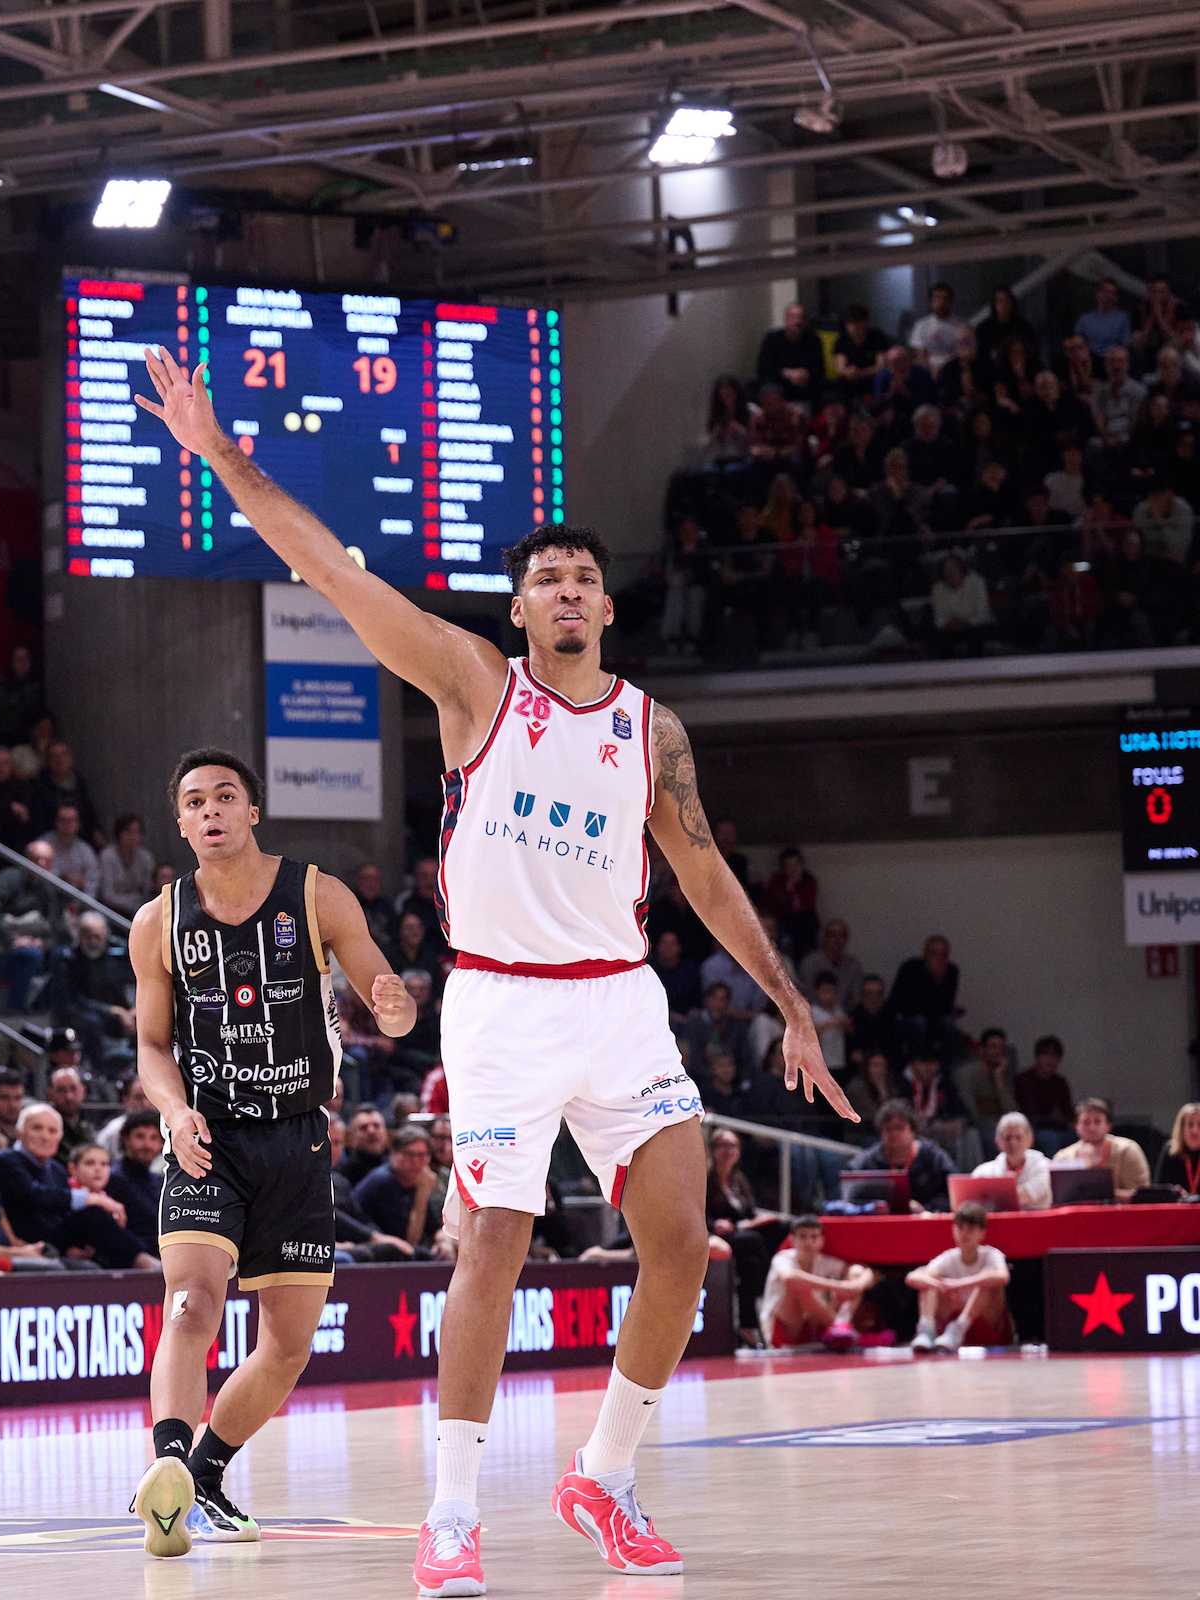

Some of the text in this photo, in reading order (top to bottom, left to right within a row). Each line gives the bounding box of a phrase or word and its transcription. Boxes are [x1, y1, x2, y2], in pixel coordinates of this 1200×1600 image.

[243, 348, 287, 389] 21
[352, 356, 398, 394] 19
[513, 689, 552, 721] 26
[908, 756, 953, 817] E
[1146, 787, 1173, 824] 0
[485, 820, 528, 847] UNA
[183, 929, 212, 965] 68
[239, 1021, 275, 1038] ITAS
[240, 1036, 267, 1045] MUTUA
[221, 1056, 310, 1082] Dolomiti
[455, 1127, 516, 1147] GME
[169, 1184, 222, 1197] CAVIT
[299, 1256, 324, 1265] MUTUA
[300, 1242, 331, 1259] ITAS
